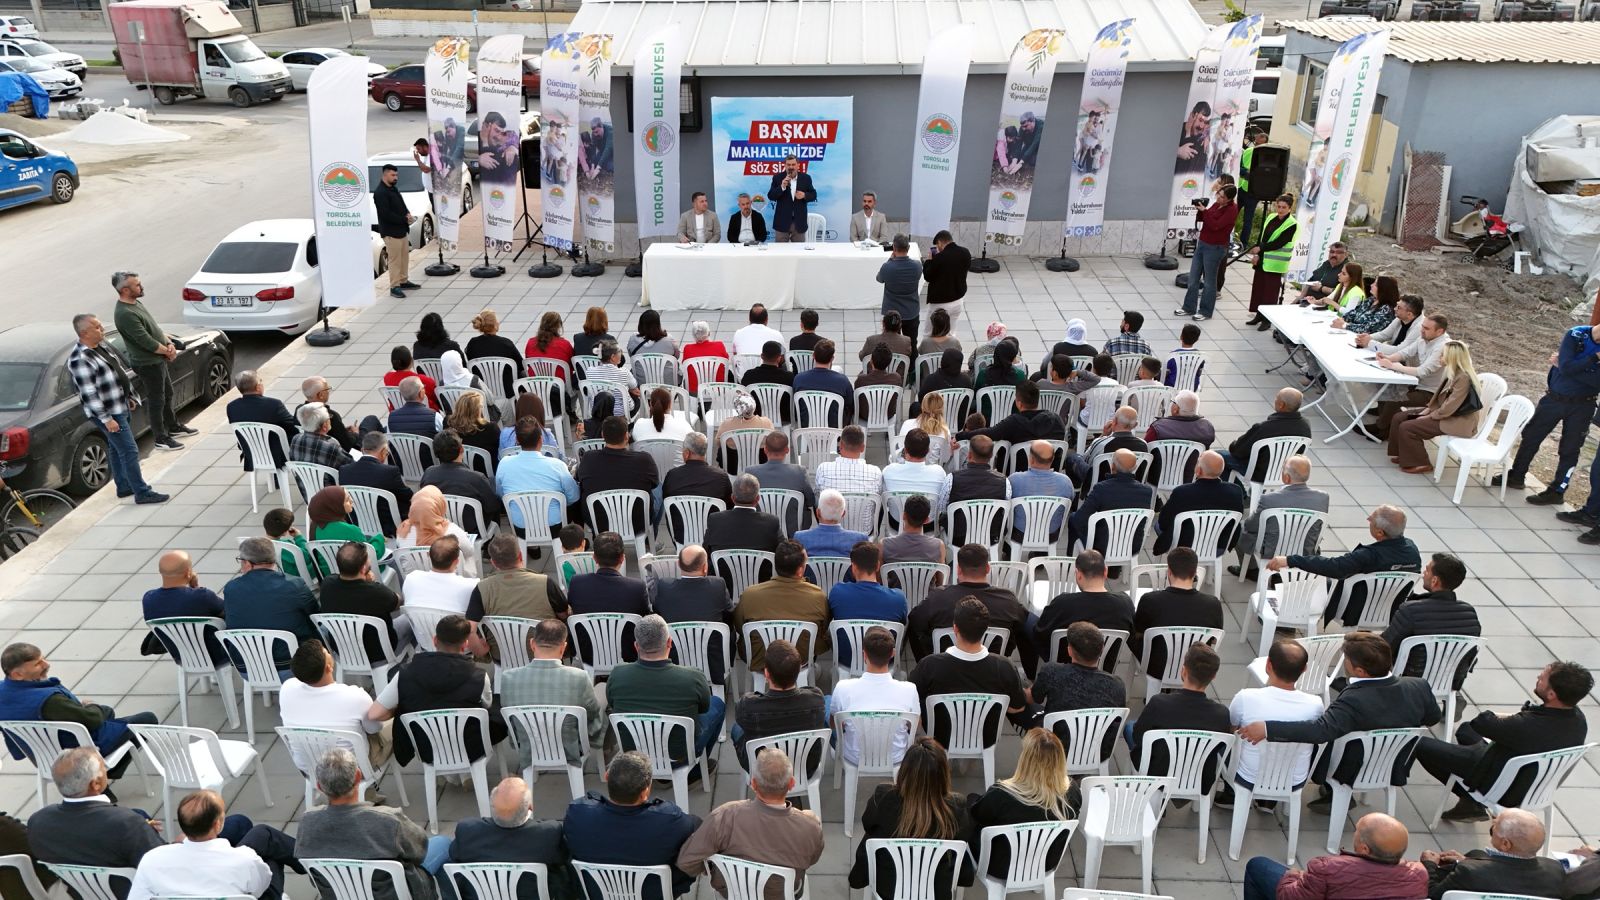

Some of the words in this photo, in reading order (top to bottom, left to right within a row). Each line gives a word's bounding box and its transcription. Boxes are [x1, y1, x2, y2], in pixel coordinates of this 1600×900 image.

[481, 75, 521, 88] Gücümüz
[651, 42, 665, 118] BELEDİYESİ
[431, 88, 465, 101] Gücümüz
[1010, 82, 1048, 94] Gücümüz
[758, 123, 828, 143] BAŞKAN
[731, 144, 824, 158] MAHALLENİZDE
[750, 161, 770, 173] SÖZ
[18, 169, 39, 181] ZABITA
[654, 160, 665, 226] TOROSLAR
[326, 219, 363, 227] BELEDİYESİ
